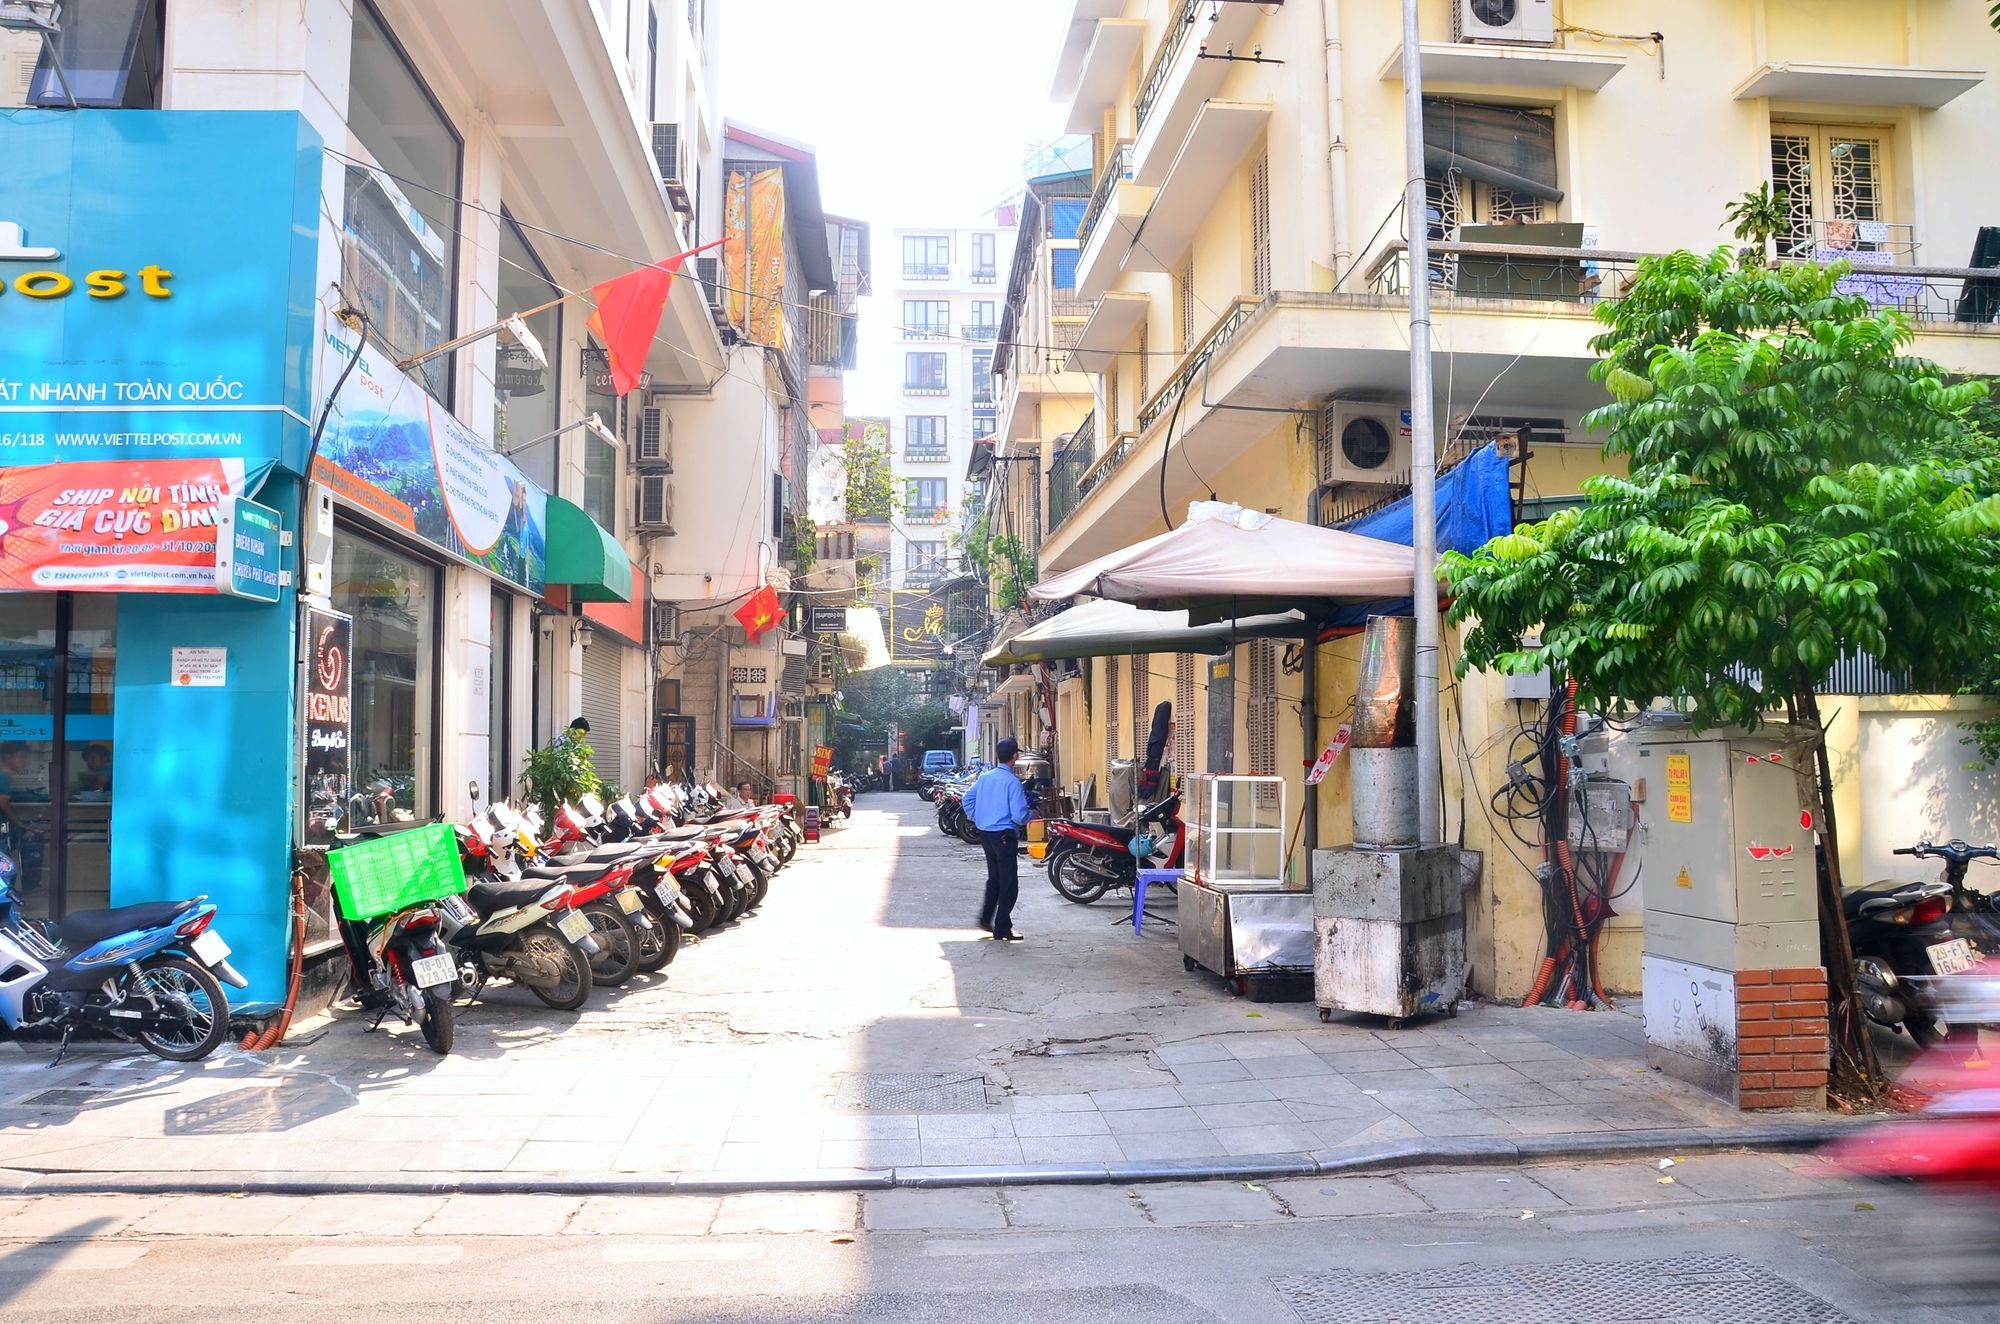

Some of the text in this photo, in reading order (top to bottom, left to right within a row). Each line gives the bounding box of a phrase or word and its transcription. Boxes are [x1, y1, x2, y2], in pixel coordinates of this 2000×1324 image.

[0, 264, 173, 299] ost
[29, 382, 107, 401] NHANH
[113, 378, 172, 401] TOÀN
[178, 374, 244, 401] QUỐC
[55, 432, 242, 446] WWW.VIETTELPOST.COM.VN
[53, 488, 115, 506] SHIP
[118, 483, 161, 509] NỘI
[33, 507, 88, 532] GIÁ
[94, 508, 152, 540] CỰC
[84, 544, 109, 556] gian
[308, 692, 348, 724] KENUS
